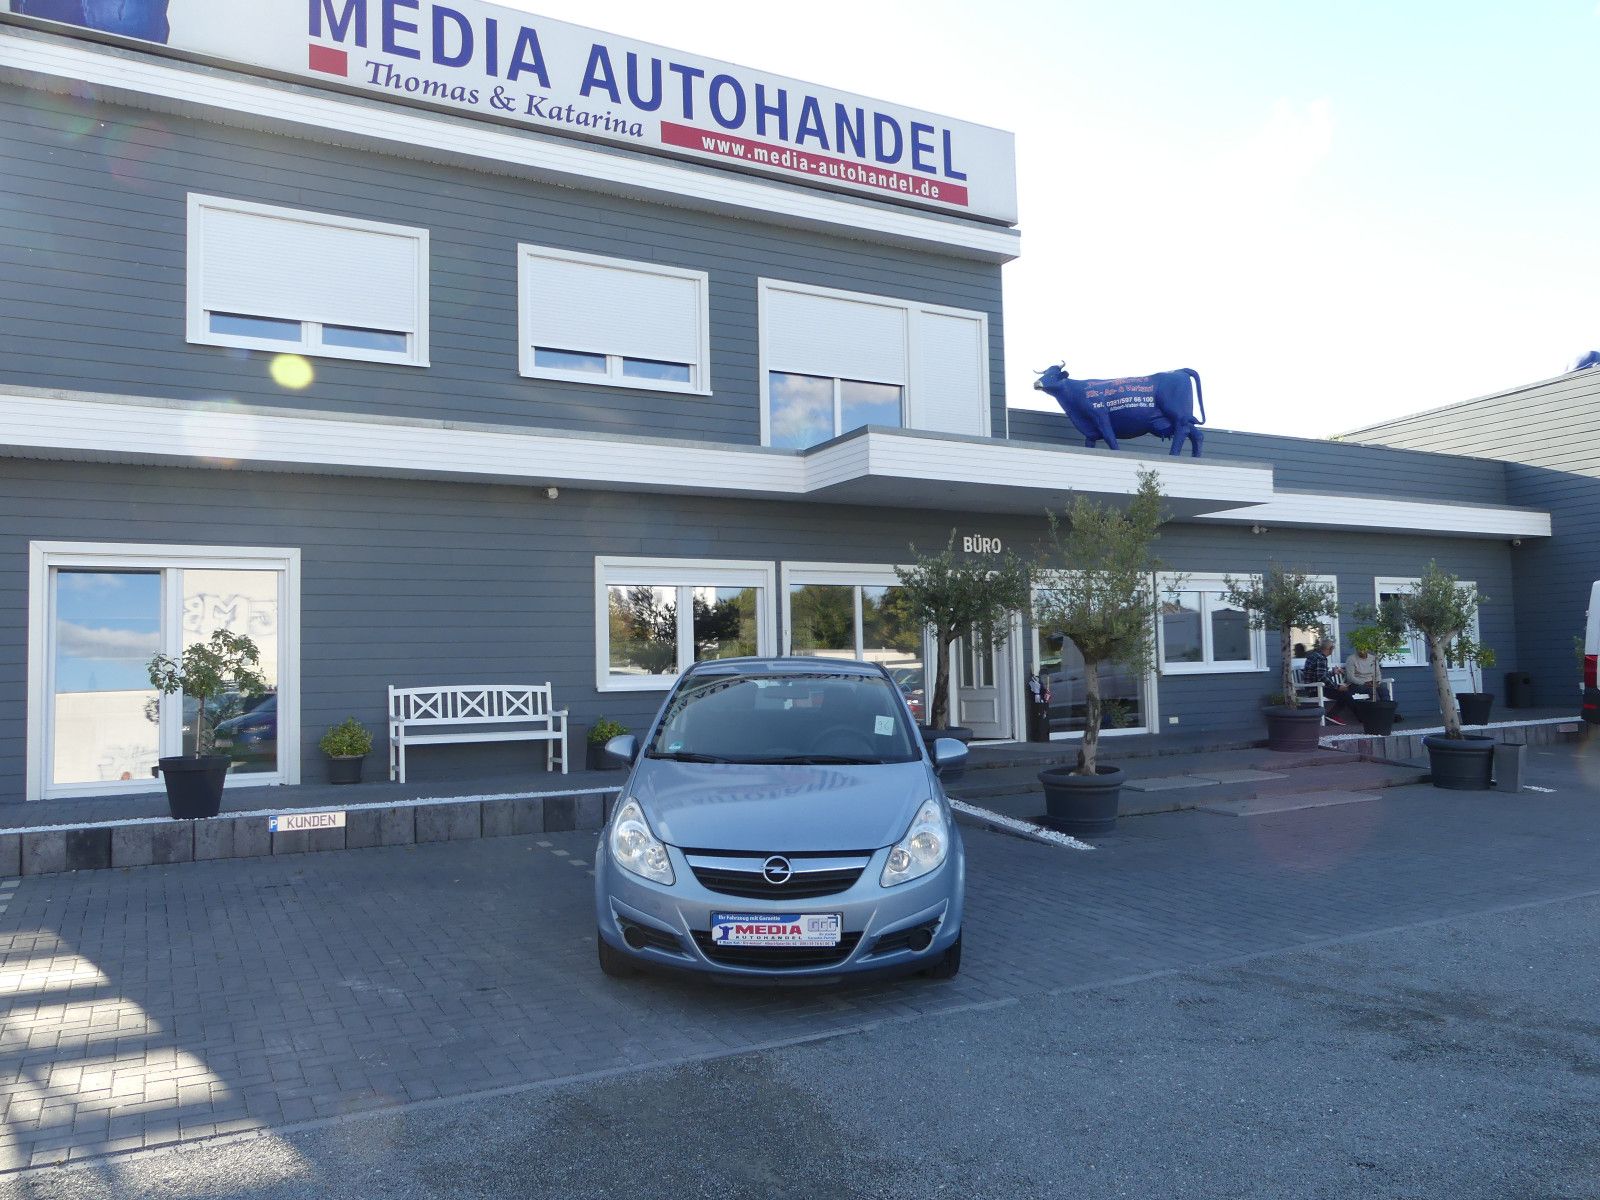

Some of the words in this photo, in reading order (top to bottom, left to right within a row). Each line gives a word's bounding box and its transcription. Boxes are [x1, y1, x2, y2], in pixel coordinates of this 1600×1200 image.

[308, 0, 551, 89] MEDIA
[579, 43, 967, 181] AUTOHANDEL
[365, 60, 479, 105] Thomas
[490, 85, 516, 112] &
[523, 93, 644, 138] Katarina
[701, 134, 940, 199] www.media-autohandel.de
[963, 534, 1001, 553] BÜRO
[270, 820, 277, 829] P
[287, 814, 336, 829] KUNDEN
[735, 925, 802, 934] MEDIA
